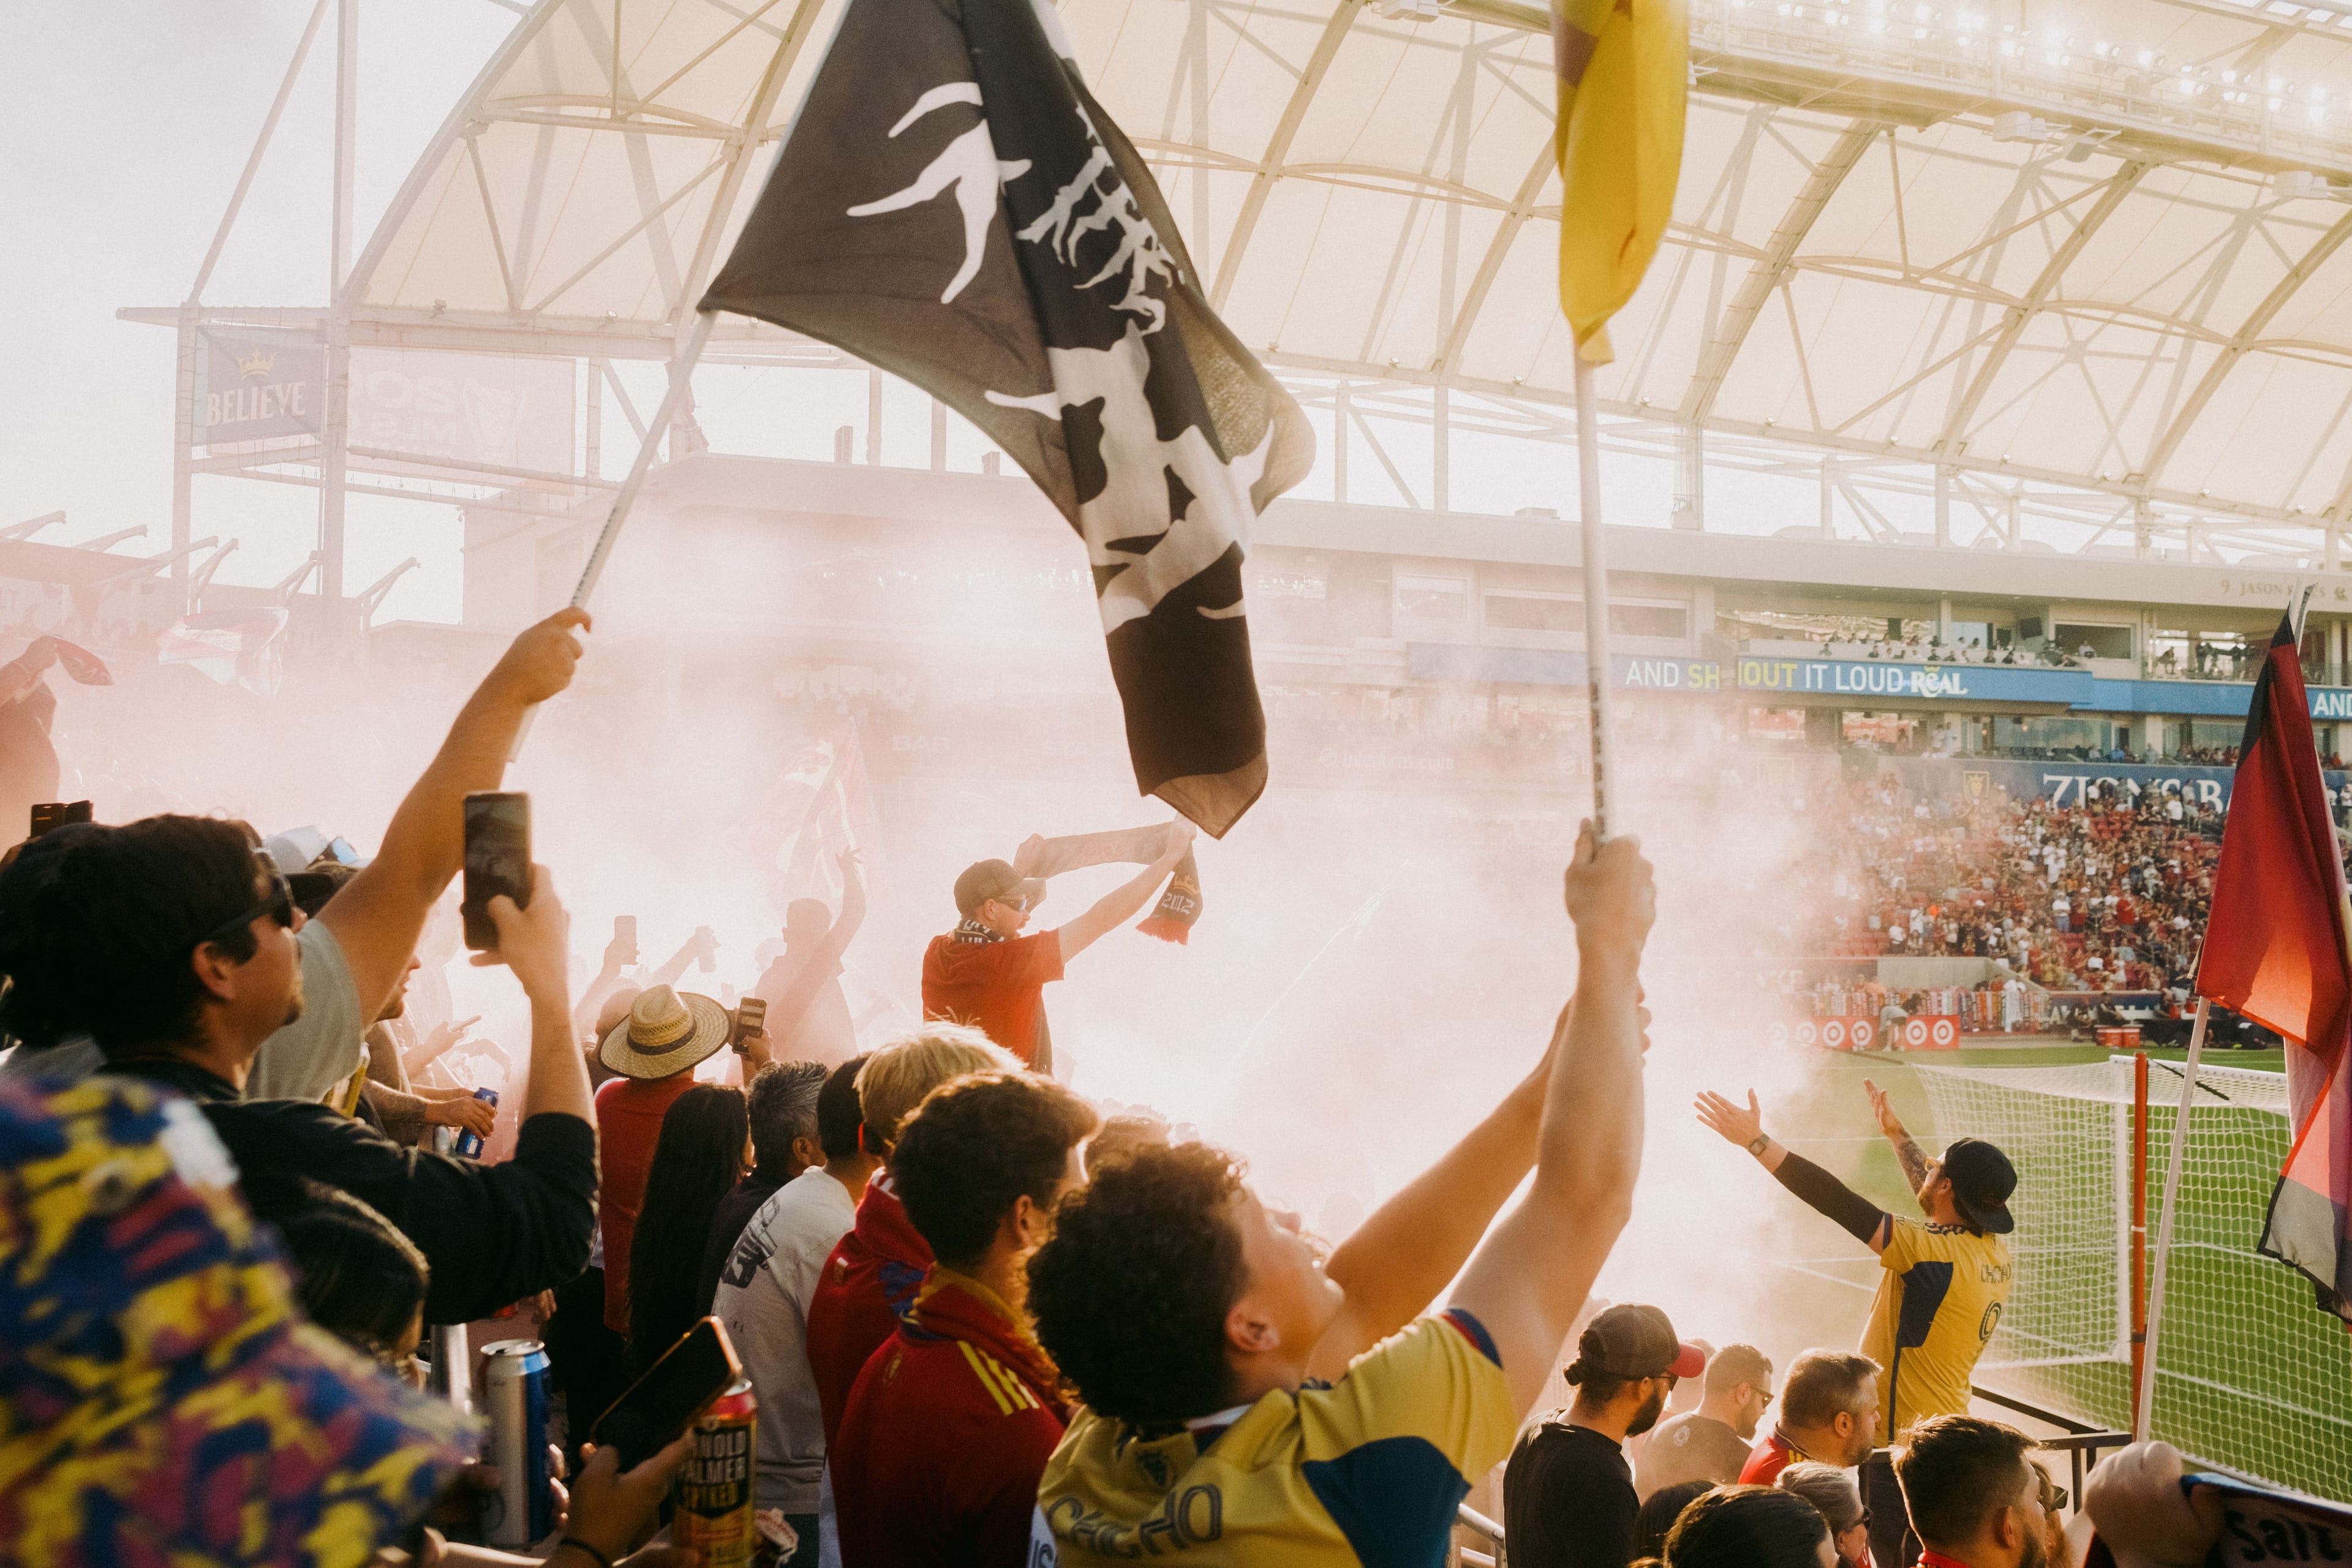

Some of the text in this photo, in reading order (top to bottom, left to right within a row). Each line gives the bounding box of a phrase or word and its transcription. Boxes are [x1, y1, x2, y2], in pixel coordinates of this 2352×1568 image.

[206, 382, 306, 427] BELIEVE
[2221, 579, 2230, 594] 9
[2241, 582, 2282, 596] JASON
[1626, 660, 1679, 687] AND
[1805, 664, 1828, 689] IT
[1835, 665, 1904, 693] LOUD
[2196, 779, 2231, 814] B
